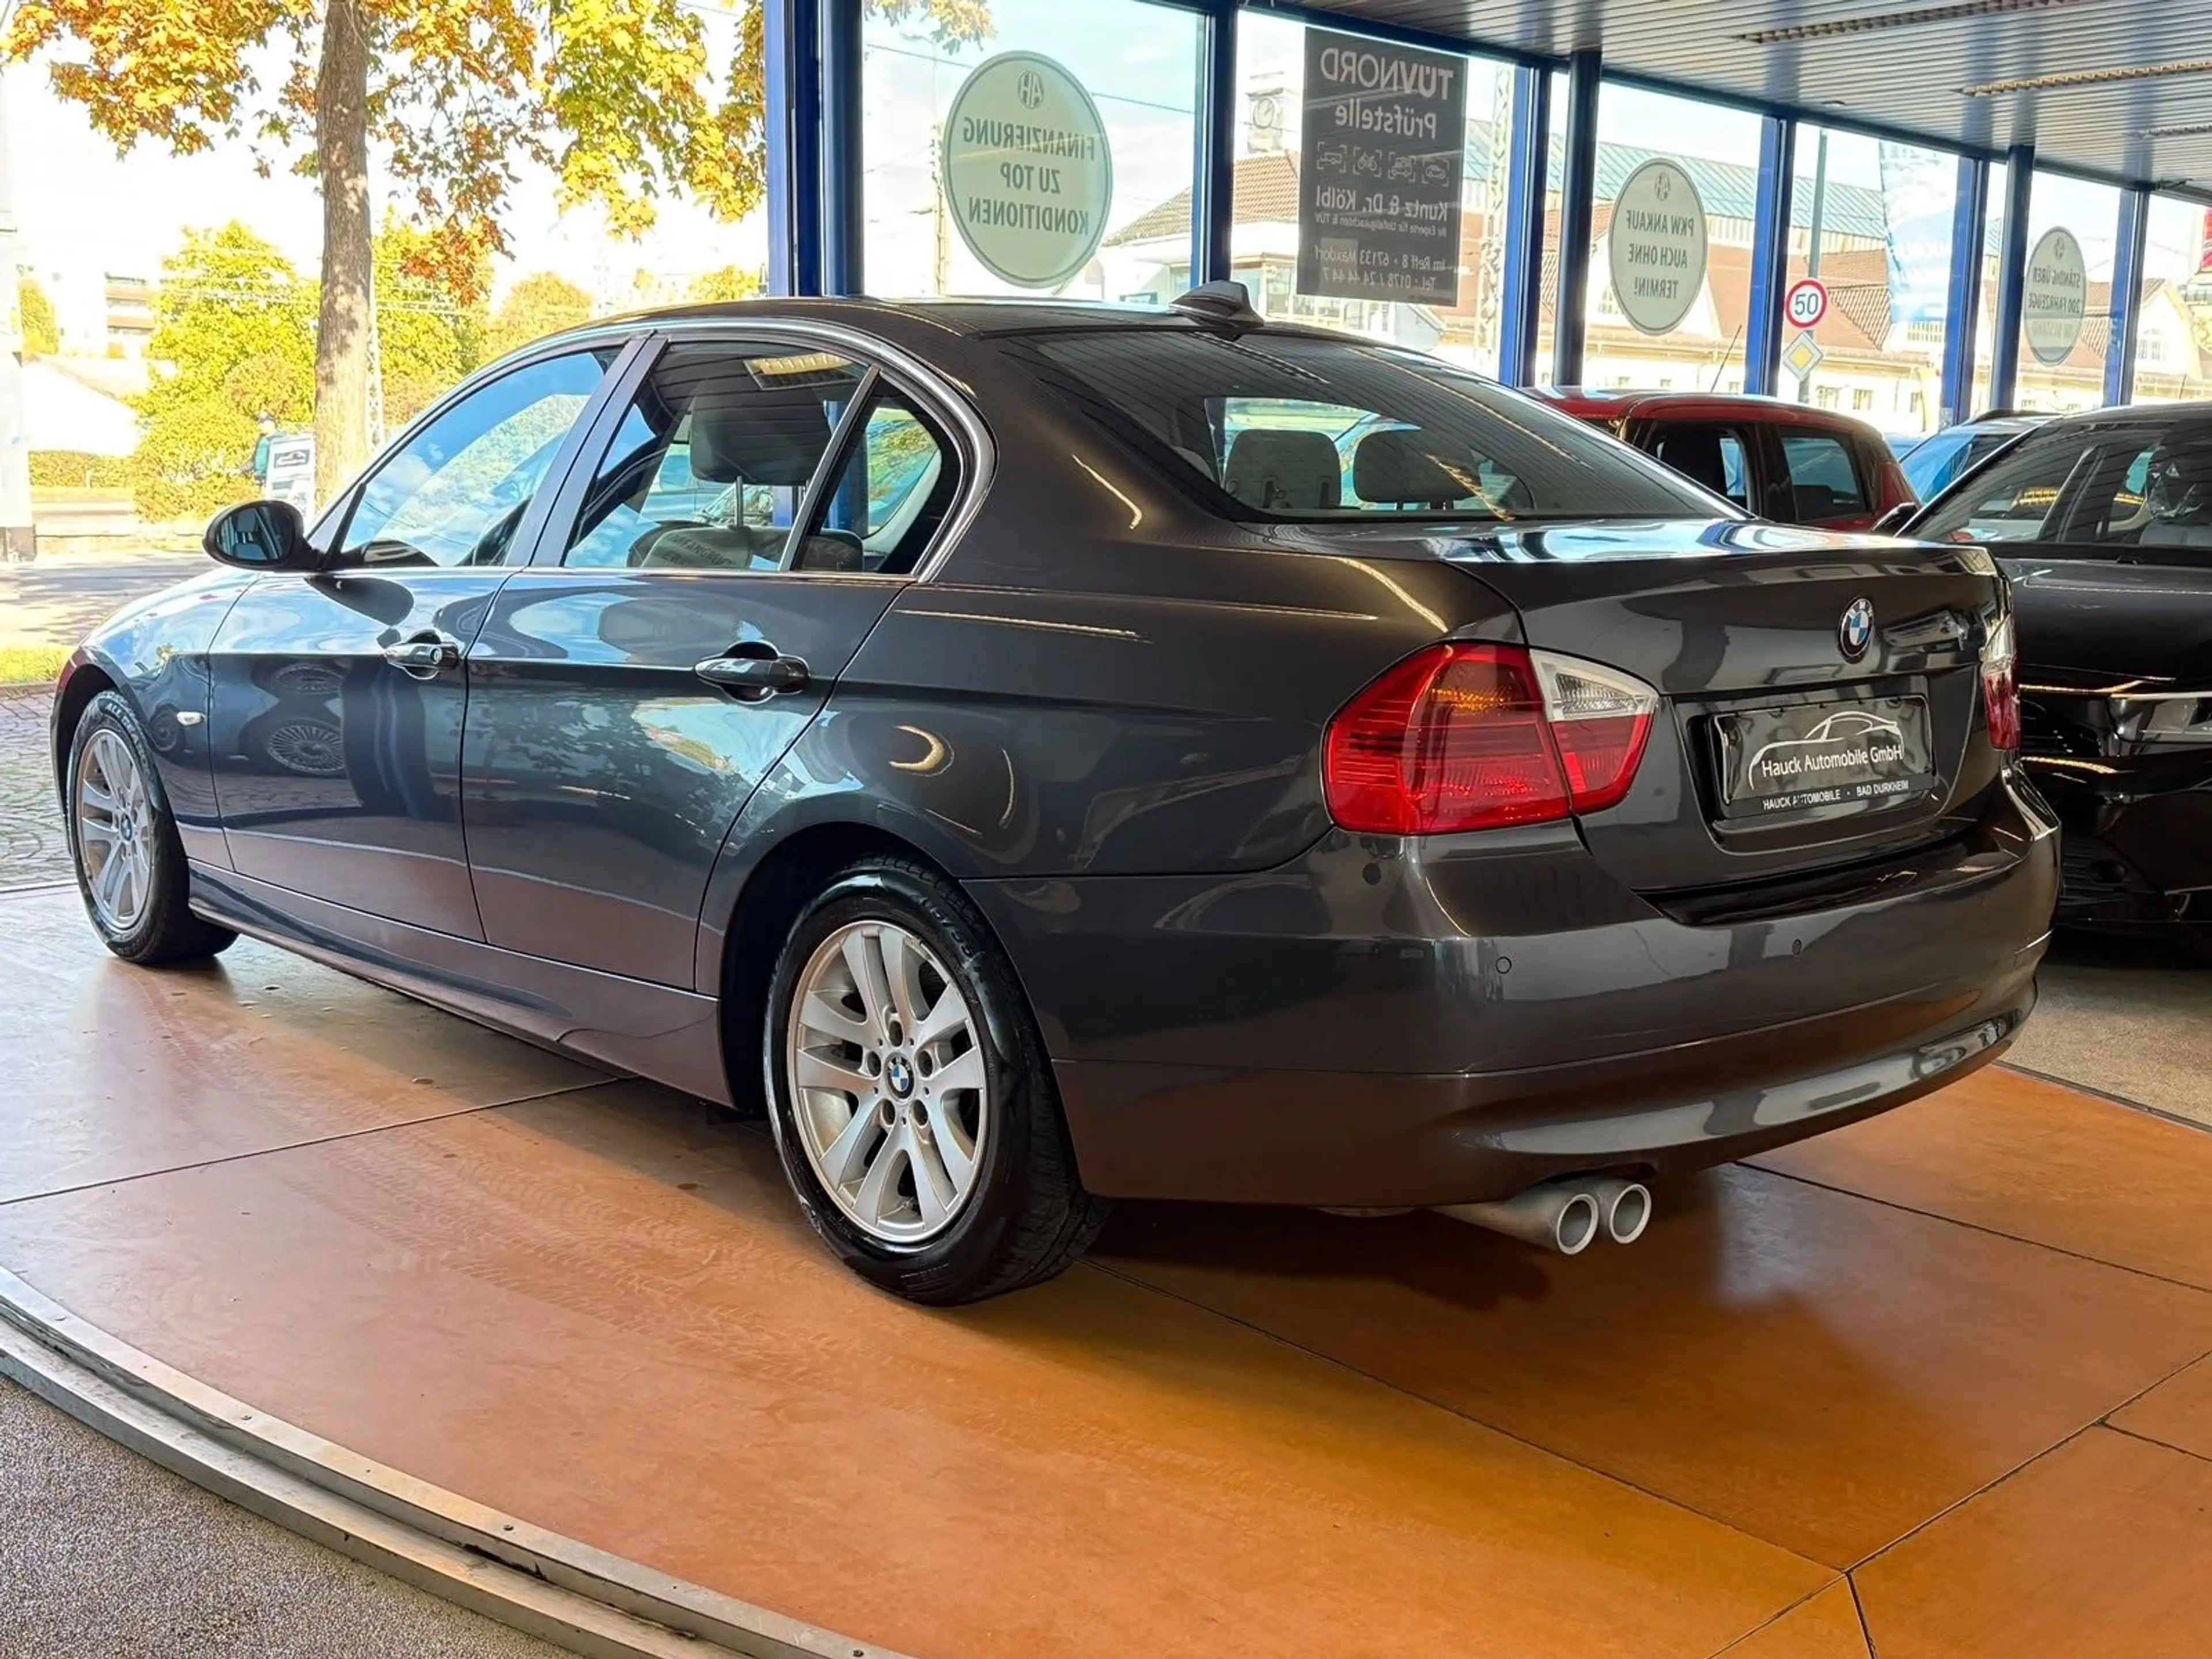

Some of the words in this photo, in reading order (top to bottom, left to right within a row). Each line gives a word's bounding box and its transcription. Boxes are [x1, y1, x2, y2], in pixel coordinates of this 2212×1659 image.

[1794, 293, 1819, 316] 50
[1761, 756, 1802, 778] Hauck
[1804, 748, 1869, 773] Automobile
[1870, 744, 1903, 763] GmbH
[1763, 797, 1791, 810] HAUCK
[1856, 785, 1873, 797] BAD
